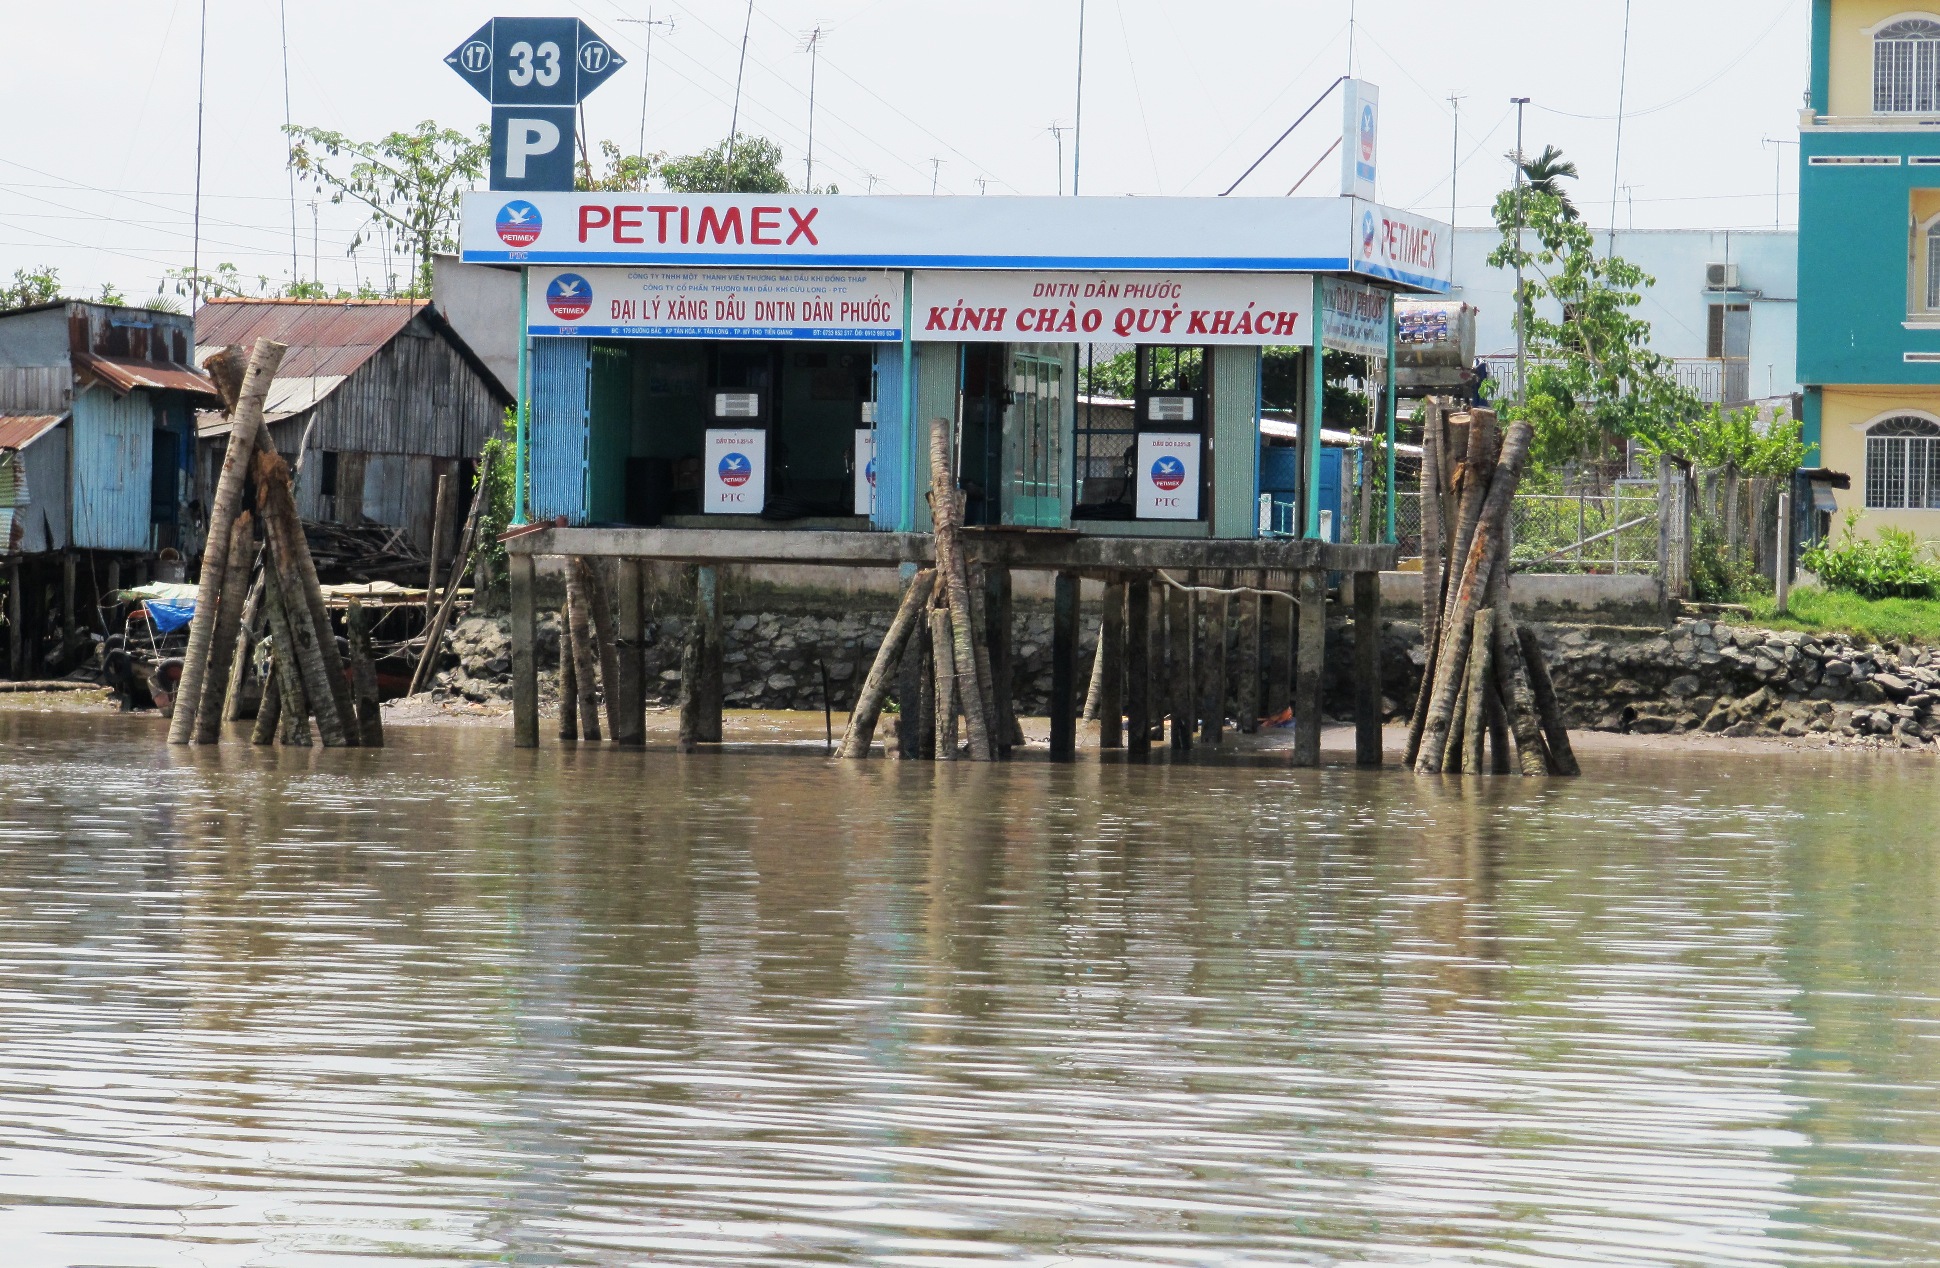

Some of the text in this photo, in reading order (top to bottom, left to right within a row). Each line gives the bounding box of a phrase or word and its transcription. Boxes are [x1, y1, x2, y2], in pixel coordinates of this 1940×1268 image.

[466, 46, 485, 68] 17
[508, 41, 561, 87] 33
[584, 47, 604, 69] 17
[505, 118, 560, 179] P
[578, 204, 819, 246] PETIMEX
[502, 233, 535, 241] PETIMEX
[1381, 218, 1437, 270] PETIMEX
[832, 286, 847, 294] PTC
[1033, 279, 1182, 299] DNTN DÂN PHƯỚC
[553, 307, 585, 315] PETIMEX
[611, 293, 891, 323] ĐẠI LÝ XĂNG DẦU DNTN DÂN PHƯỚC
[925, 299, 1008, 332] KÍNH
[1015, 300, 1102, 333] CHÀO
[1186, 301, 1299, 336] KHÁCH
[721, 493, 746, 502] PTC
[1155, 497, 1180, 507] PTC
